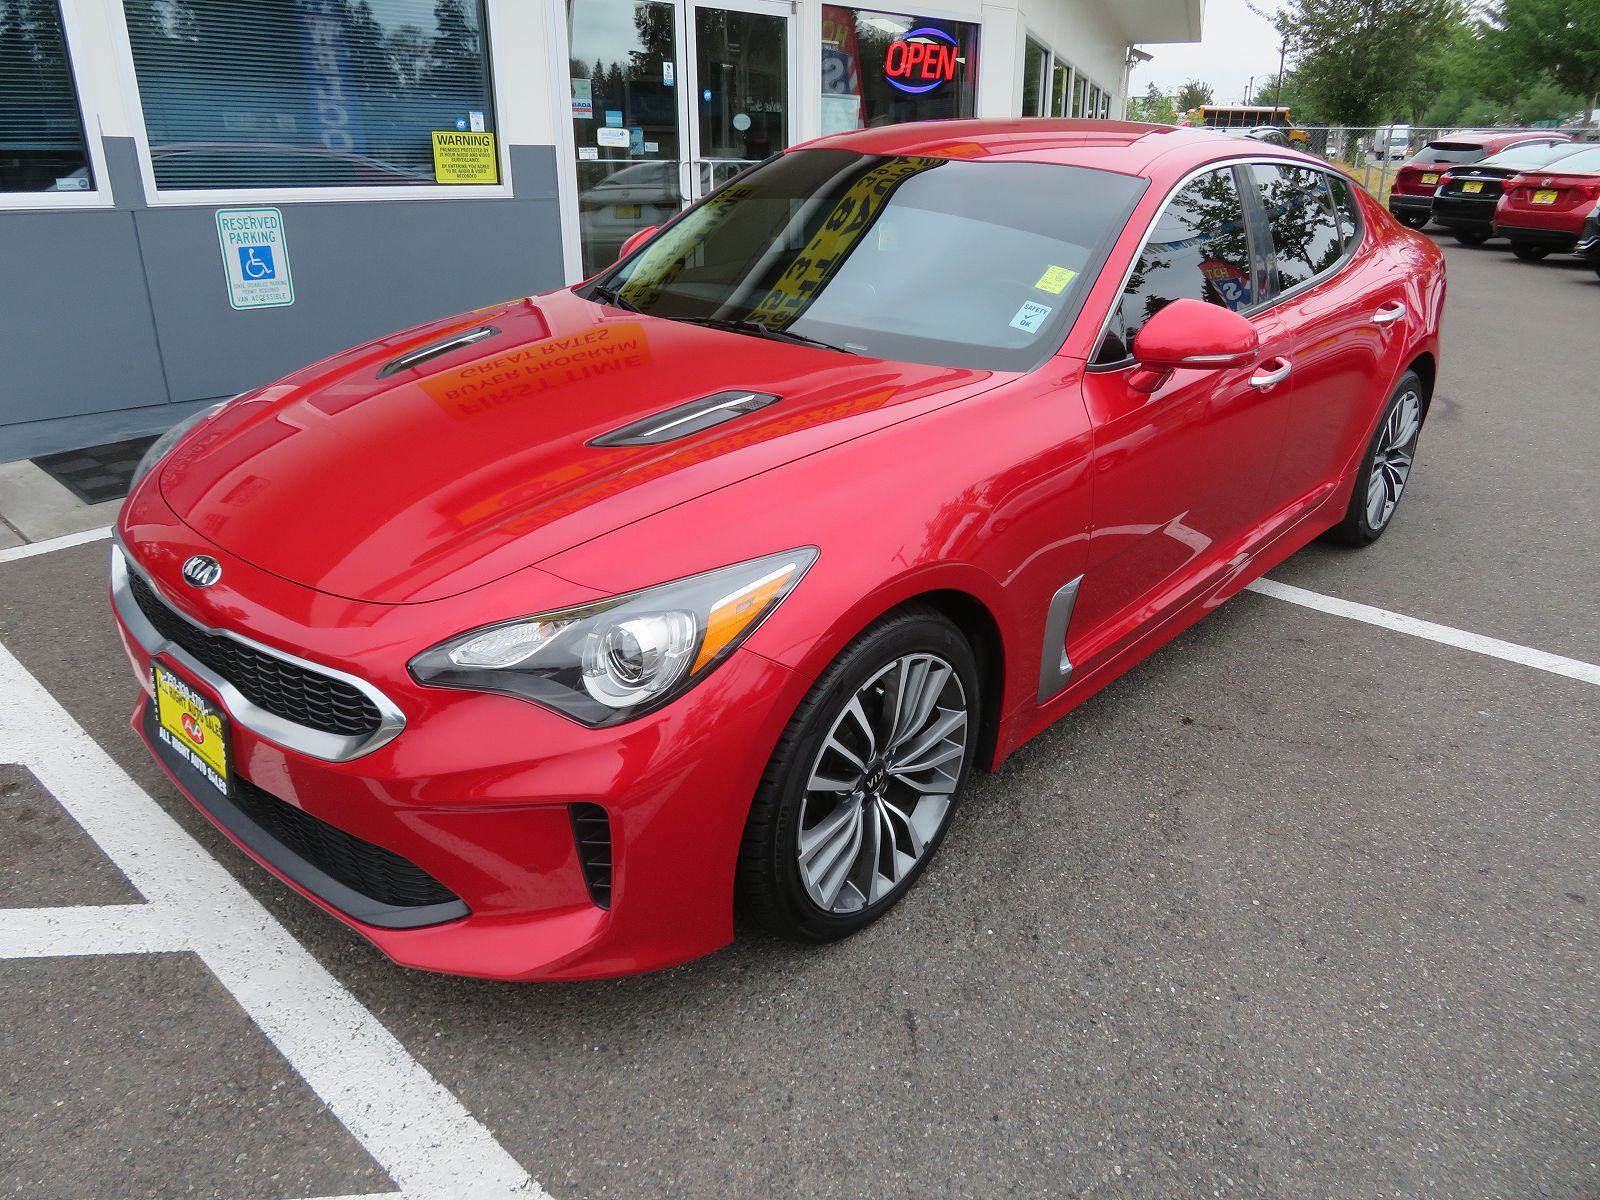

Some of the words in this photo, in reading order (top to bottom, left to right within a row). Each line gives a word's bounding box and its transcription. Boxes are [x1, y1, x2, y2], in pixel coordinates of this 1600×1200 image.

[886, 41, 958, 81] OPEN
[437, 135, 490, 146] WARNING
[223, 217, 278, 231] RESERVED
[229, 231, 276, 244] PARKING
[252, 293, 286, 301] ACCESSIBLE
[1024, 304, 1048, 315] SAFETY
[184, 557, 214, 584] KIA
[159, 726, 171, 745] ALL
[172, 738, 190, 760] RIGHT
[191, 752, 207, 776] AUTO
